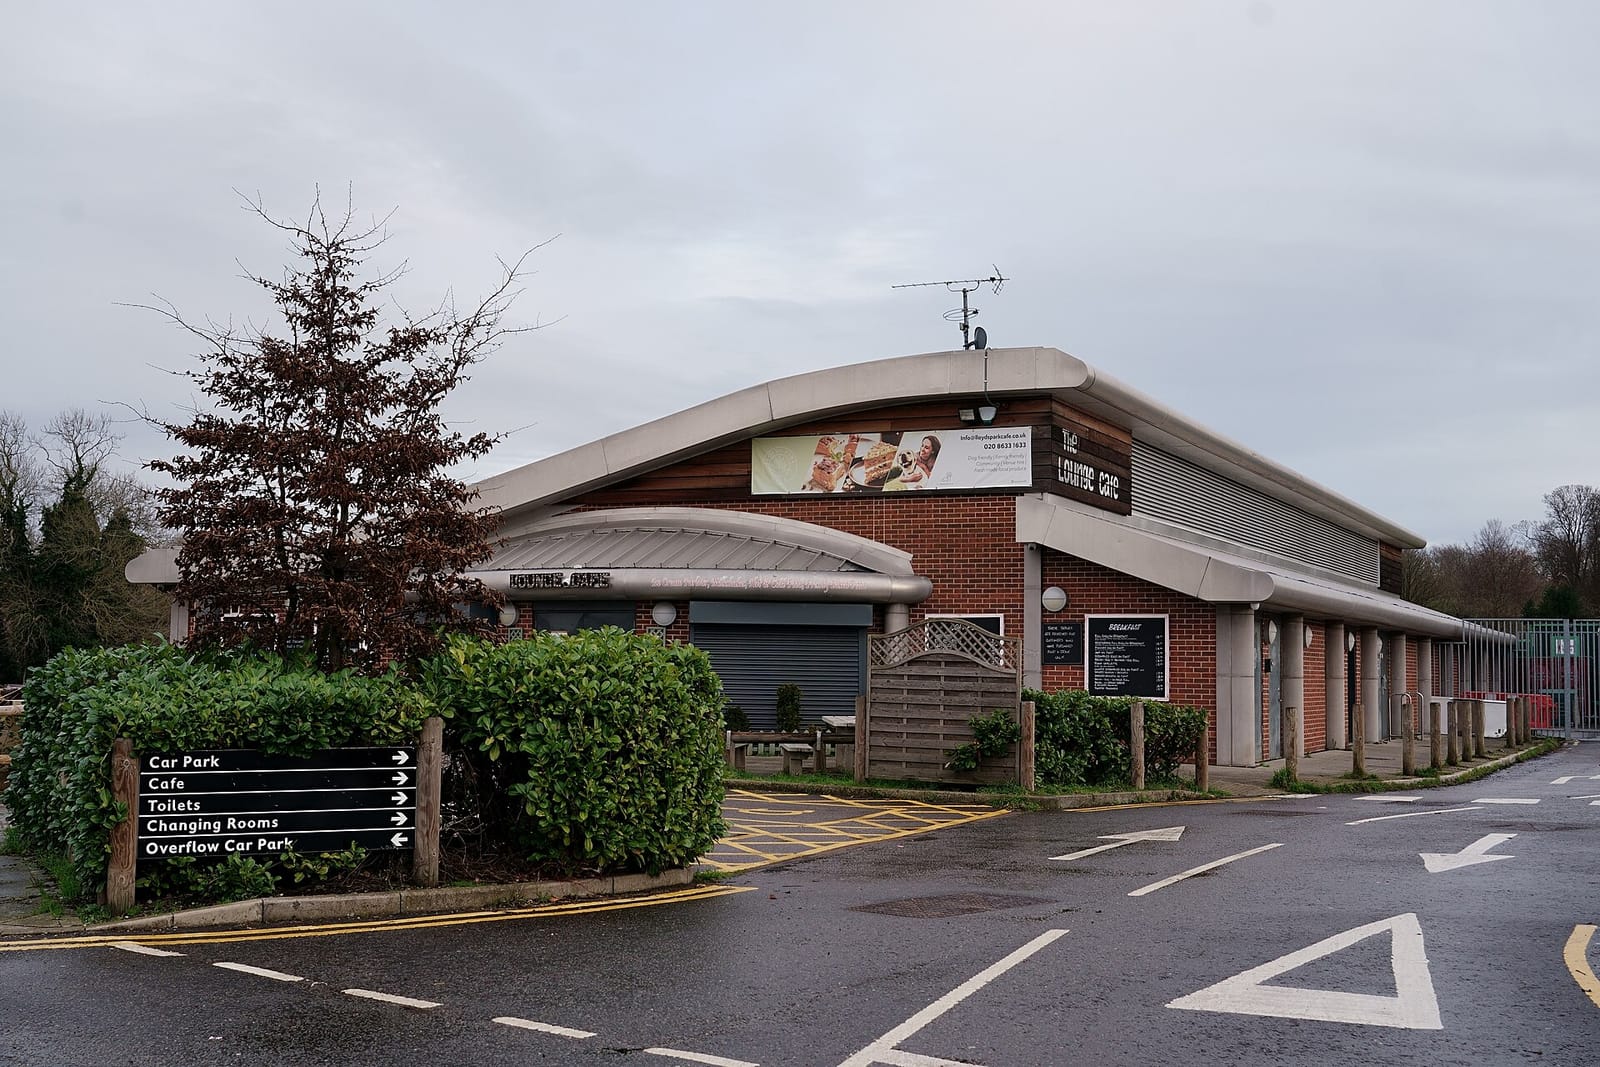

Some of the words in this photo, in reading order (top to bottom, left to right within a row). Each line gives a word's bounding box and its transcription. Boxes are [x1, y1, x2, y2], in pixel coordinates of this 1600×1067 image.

[1013, 441, 1027, 449] 1633
[1062, 429, 1078, 454] The
[1058, 456, 1095, 492] Lounge
[1098, 472, 1119, 500] Cafe
[509, 573, 563, 588] LOUNGE
[570, 573, 610, 588] CAFE
[1108, 623, 1142, 631] BREAKFAST
[149, 757, 178, 769] Car
[183, 755, 220, 768] Park
[148, 778, 185, 790] Cafe
[148, 799, 201, 812] Toilets
[146, 818, 221, 833] Changing
[227, 818, 279, 830] Rooms
[146, 841, 219, 855] Overflow
[224, 839, 253, 852] Car
[258, 837, 293, 850] Park
